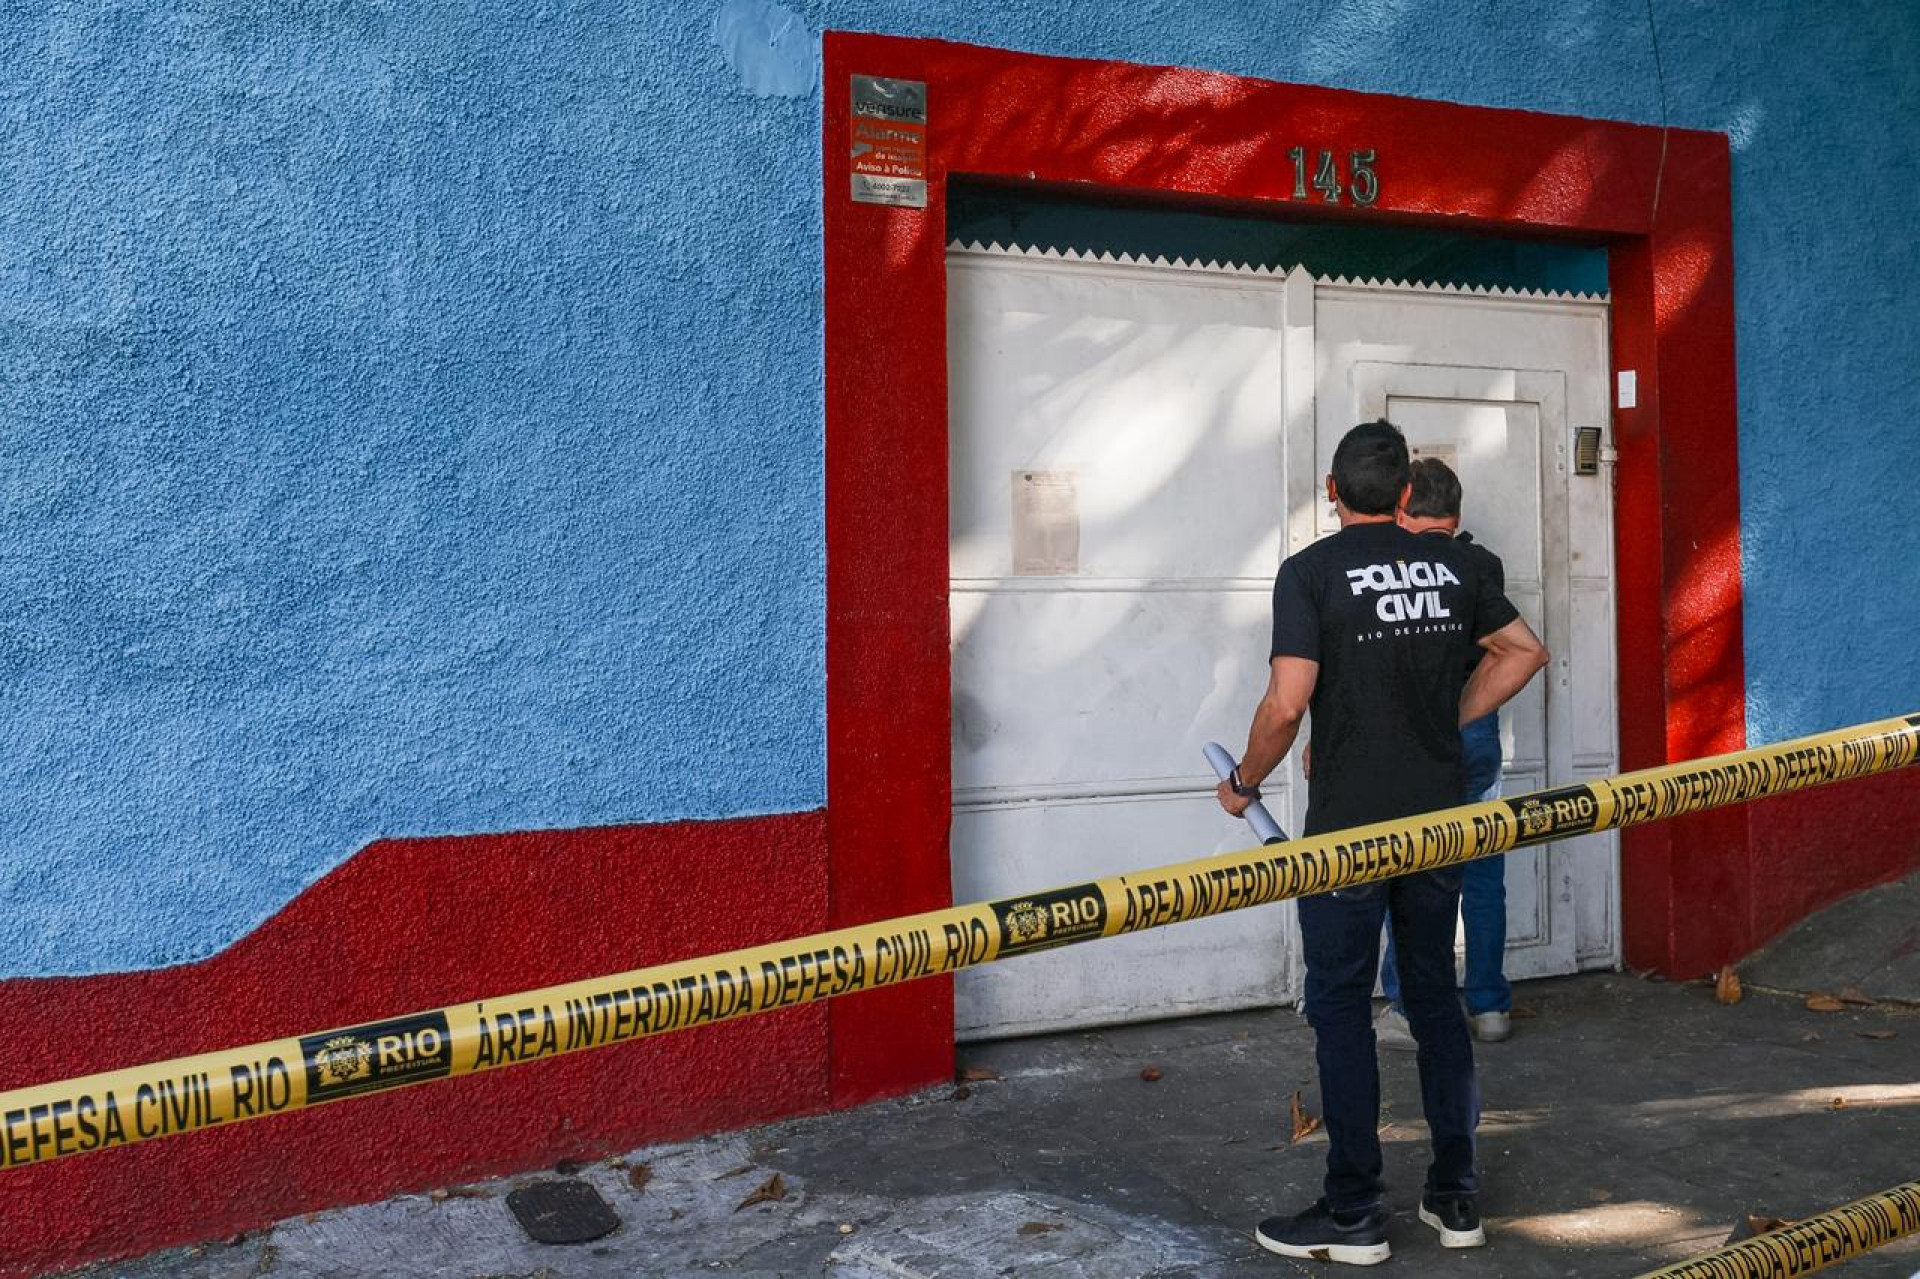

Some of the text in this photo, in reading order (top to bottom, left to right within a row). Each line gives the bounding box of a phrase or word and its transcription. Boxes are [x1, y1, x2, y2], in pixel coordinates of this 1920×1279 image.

[855, 101, 922, 119] verisure
[856, 161, 882, 173] Aviso
[1289, 146, 1378, 206] 145
[1376, 591, 1450, 622] CIVIL
[1357, 630, 1383, 642] RIO
[1395, 626, 1410, 636] DE
[1603, 780, 1657, 827] ÁREA
[1660, 758, 1770, 816] INTERDITADA
[1772, 744, 1837, 792] DEFESA
[1880, 728, 1911, 767] RIO
[1554, 796, 1592, 823] RIO
[1118, 811, 1509, 934] ÁREA INTERDITADA DEFESA CIVIL RIO
[1050, 896, 1100, 928] RIO
[473, 917, 989, 1069] ÁREA INTERDITADA DEFESA CIVIL RIO
[377, 1028, 442, 1067] RIO
[136, 1072, 223, 1139] CIVIL
[229, 1056, 291, 1119] RIO
[1769, 1214, 1855, 1277] DEFESA
[1840, 1199, 1898, 1249] CIVIL
